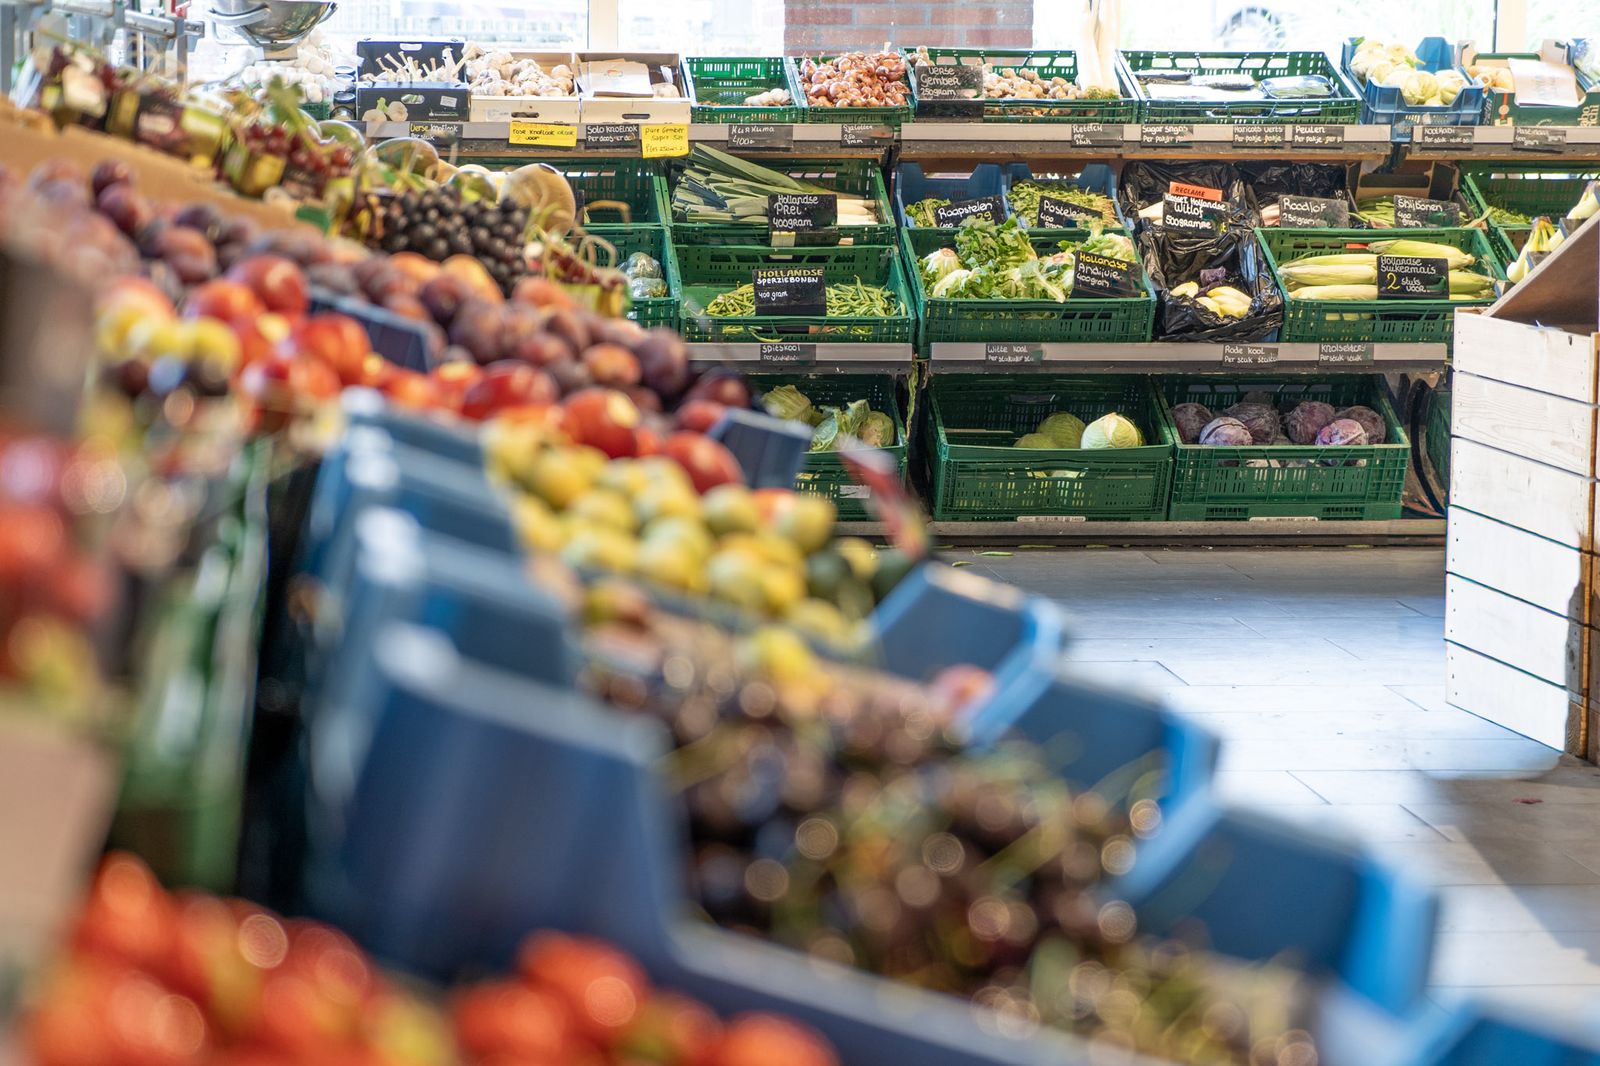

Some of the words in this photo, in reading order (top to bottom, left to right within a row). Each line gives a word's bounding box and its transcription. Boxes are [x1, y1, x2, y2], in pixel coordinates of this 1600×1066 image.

[778, 194, 819, 205] Hollandse
[1175, 186, 1206, 198] RECLAME
[938, 200, 993, 220] Raapstelen
[1174, 201, 1204, 219] Witlof
[1283, 197, 1327, 213] Roodlof
[1079, 252, 1128, 271] Hollandse
[1380, 255, 1423, 267] Hollandse
[758, 269, 824, 278] HOLLANDSE
[1386, 272, 1401, 290] 2
